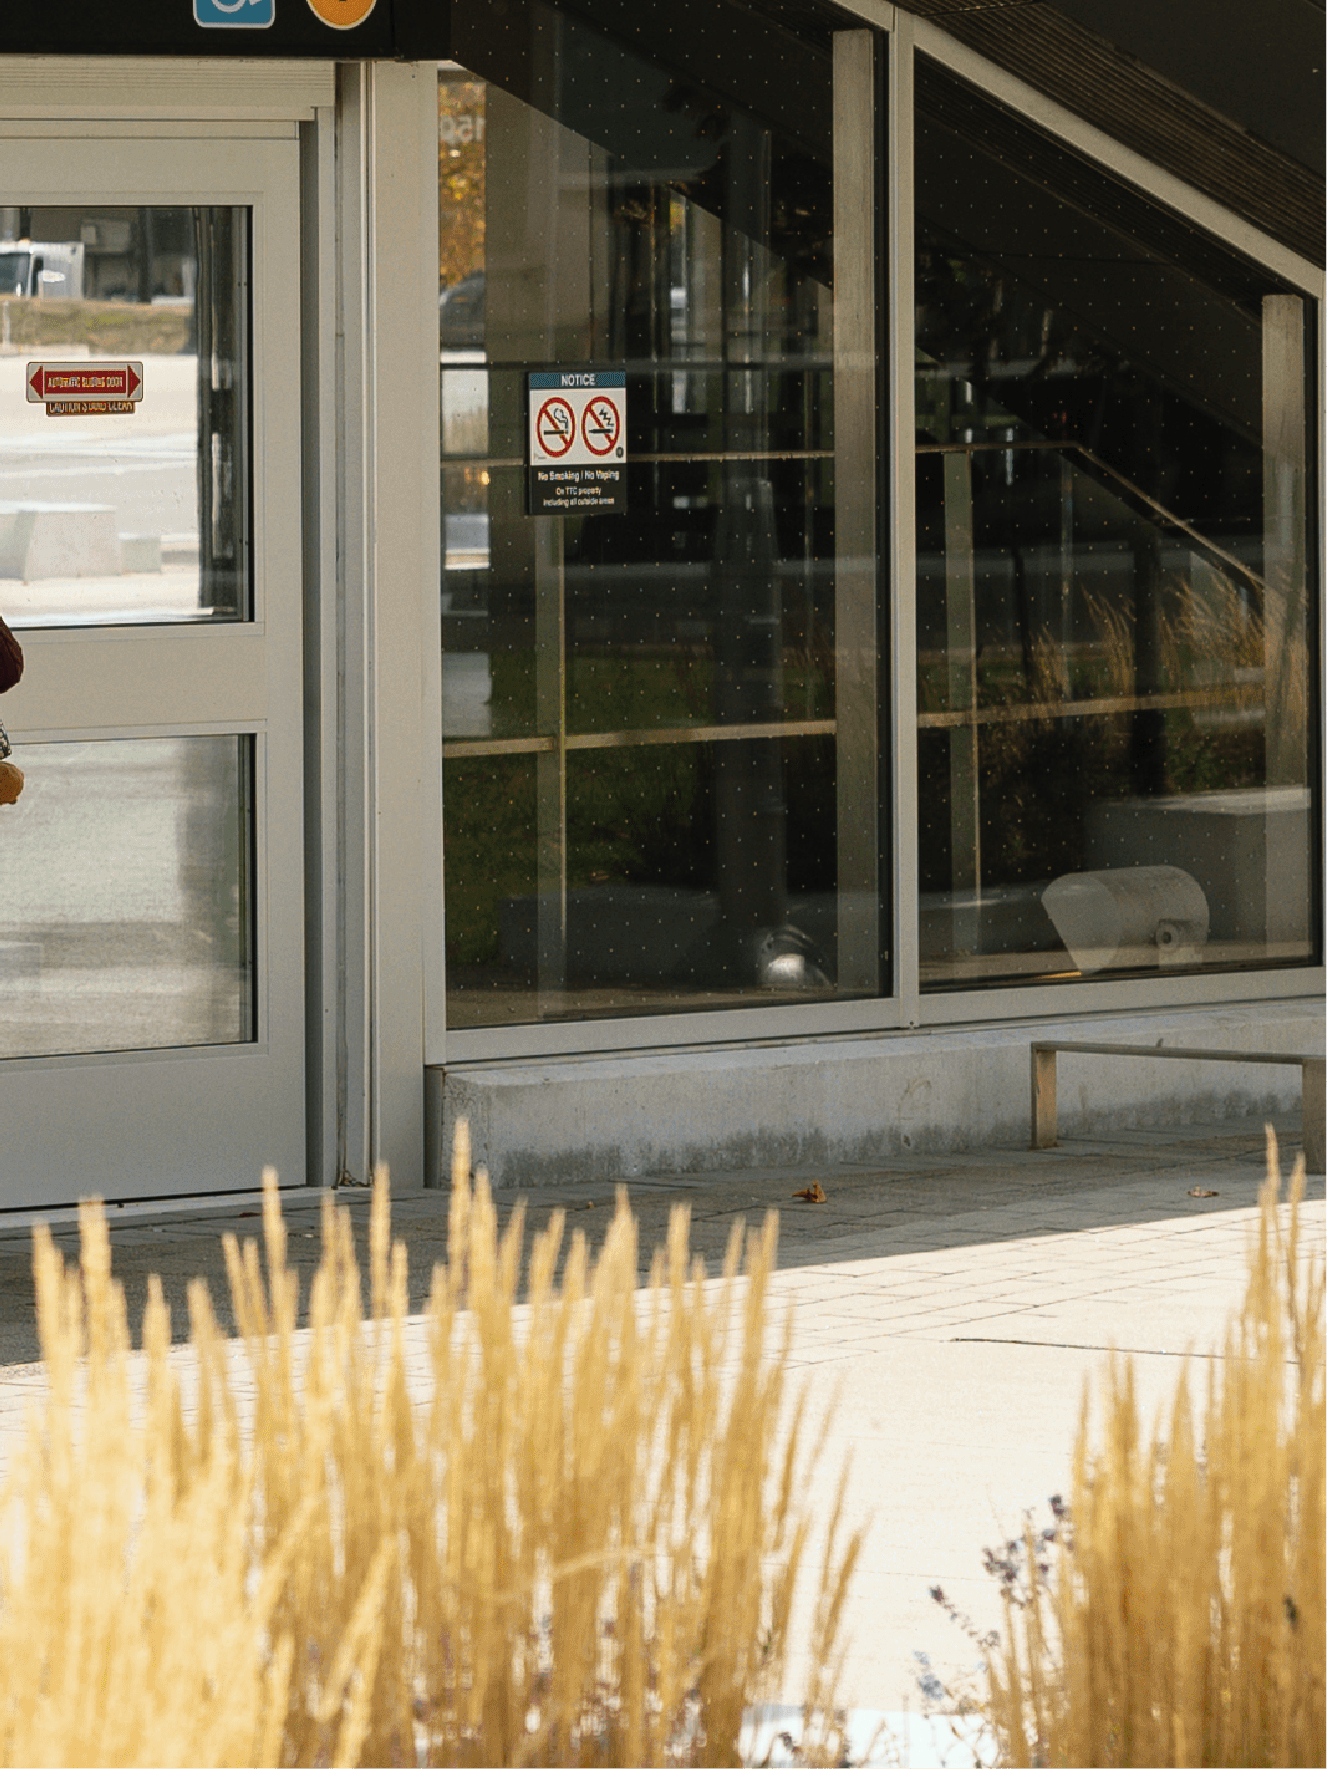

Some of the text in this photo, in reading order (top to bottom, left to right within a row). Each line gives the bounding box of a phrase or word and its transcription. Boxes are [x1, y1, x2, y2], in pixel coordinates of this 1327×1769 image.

[561, 373, 595, 387] NOTICE
[537, 469, 620, 483] No Smoking No Vaping
